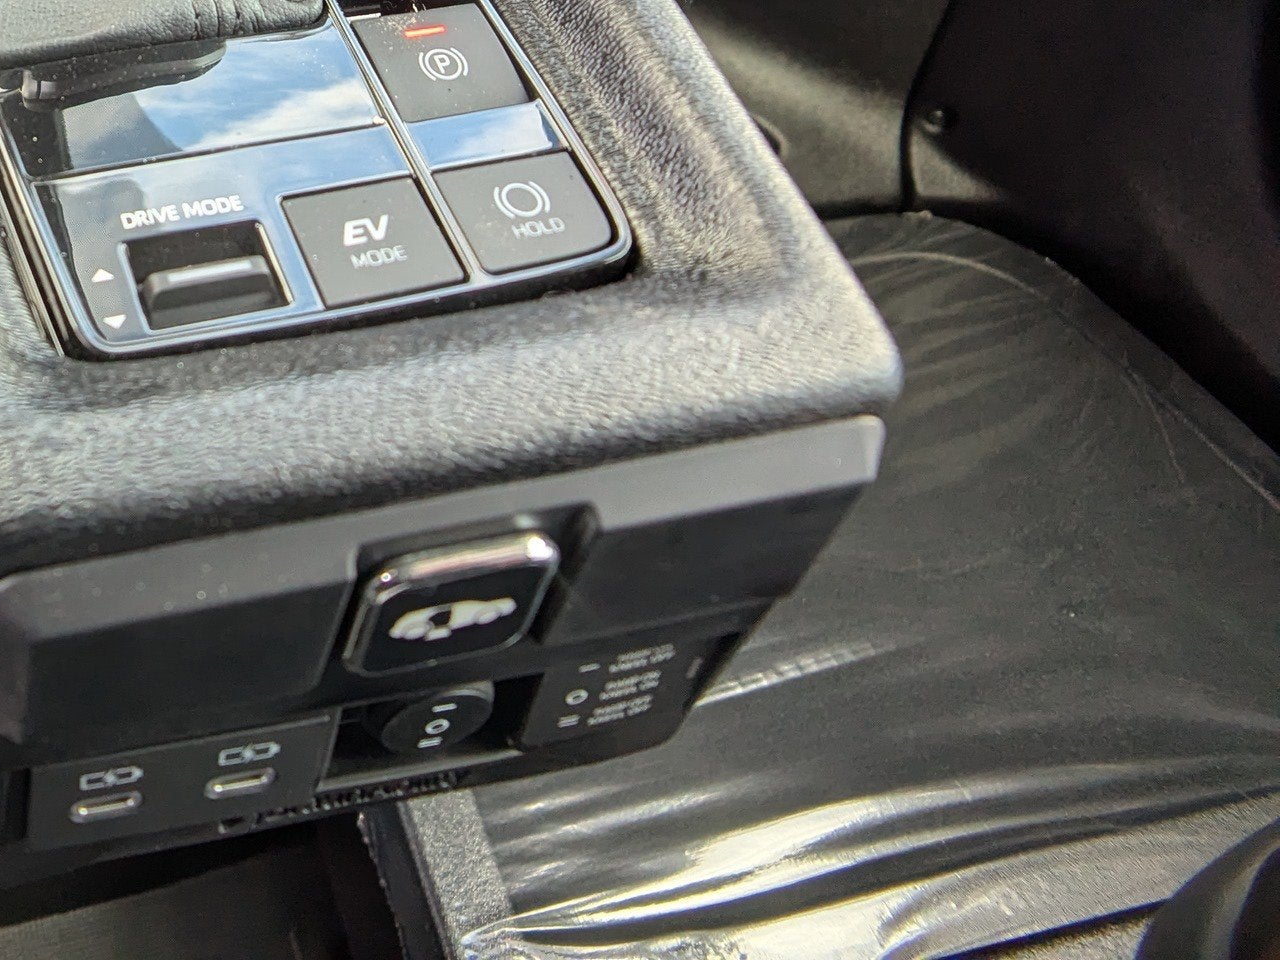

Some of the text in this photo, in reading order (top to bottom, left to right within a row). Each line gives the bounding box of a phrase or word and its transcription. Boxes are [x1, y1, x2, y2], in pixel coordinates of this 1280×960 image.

[120, 195, 245, 230] DRIVE MODE
[343, 214, 389, 246] EV
[511, 217, 566, 240] HOLD
[350, 245, 408, 269] MODE
